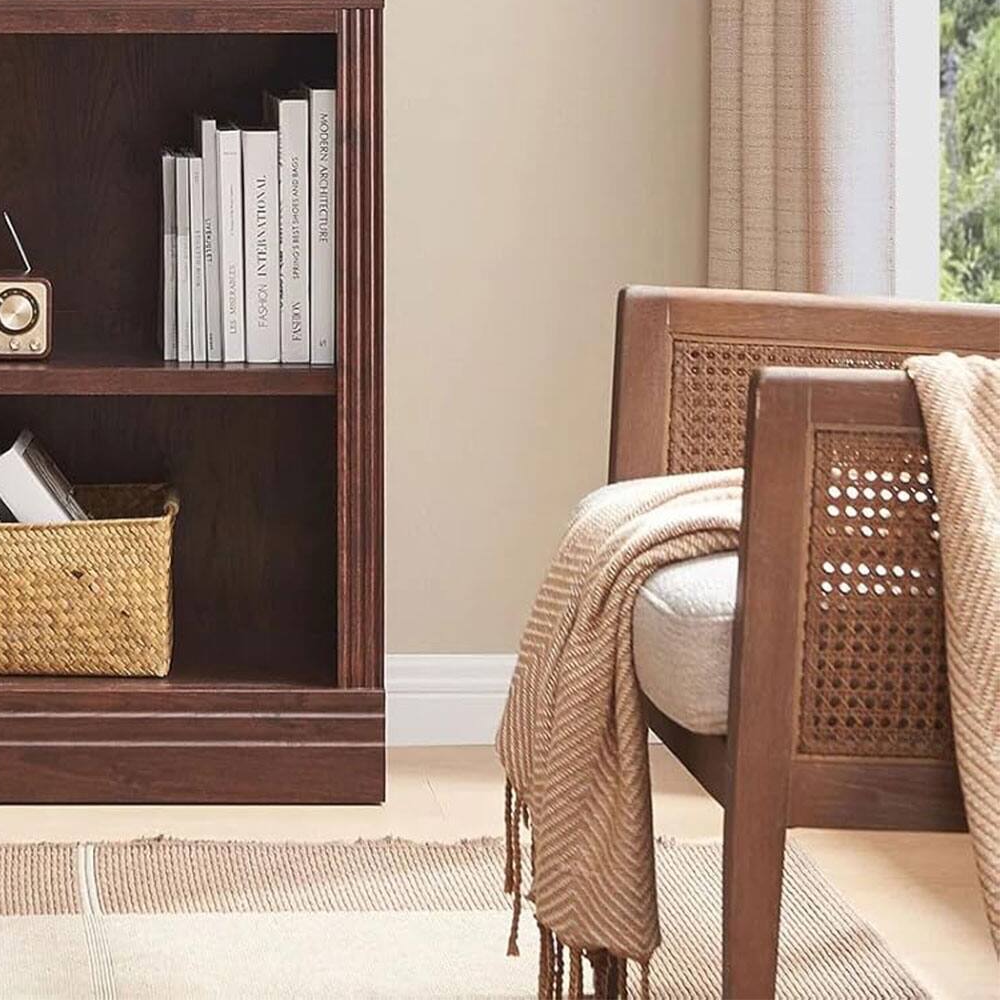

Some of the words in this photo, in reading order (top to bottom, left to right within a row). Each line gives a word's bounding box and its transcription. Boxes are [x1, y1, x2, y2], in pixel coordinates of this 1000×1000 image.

[319, 112, 328, 160] MODERN
[257, 175, 267, 277] INTERNATIONAL
[318, 164, 328, 243] ARCHITECTURE
[229, 319, 237, 335] LES
[257, 284, 267, 328] FASHION
[292, 302, 301, 341] FASHION
